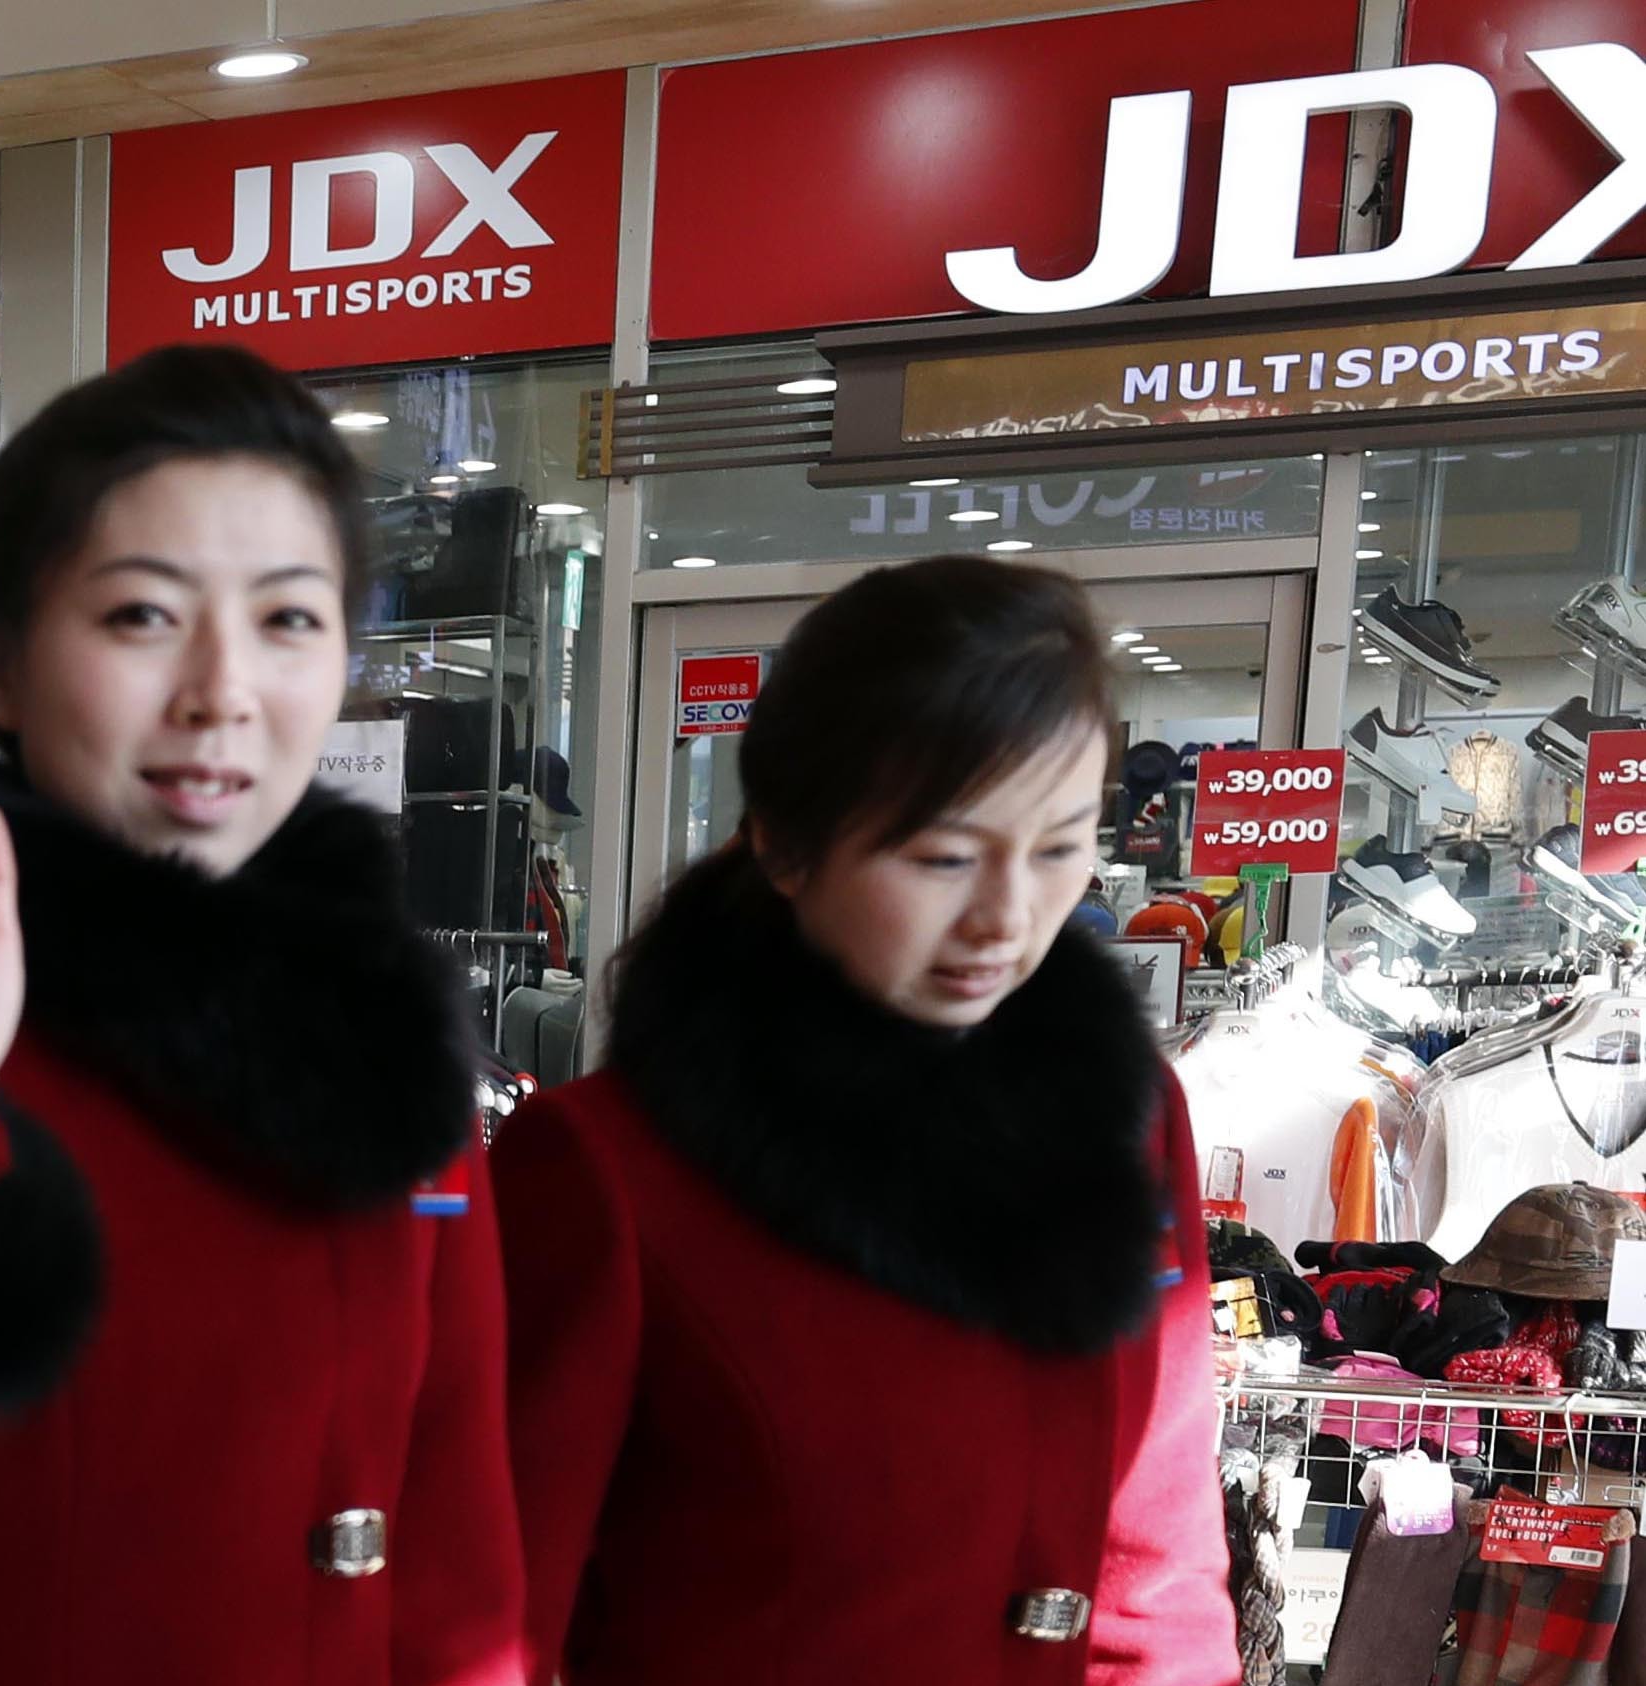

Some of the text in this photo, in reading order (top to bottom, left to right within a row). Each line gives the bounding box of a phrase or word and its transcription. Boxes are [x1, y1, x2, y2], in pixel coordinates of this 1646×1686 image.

[161, 131, 559, 283] JDX
[193, 264, 532, 328] MULTISPORTS
[1122, 330, 1602, 404] MULTISPORTS
[317, 755, 386, 773] TV작동중
[1612, 1007, 1641, 1018] JDX
[1224, 1024, 1250, 1035] JDX
[1264, 1169, 1286, 1179] JDX
